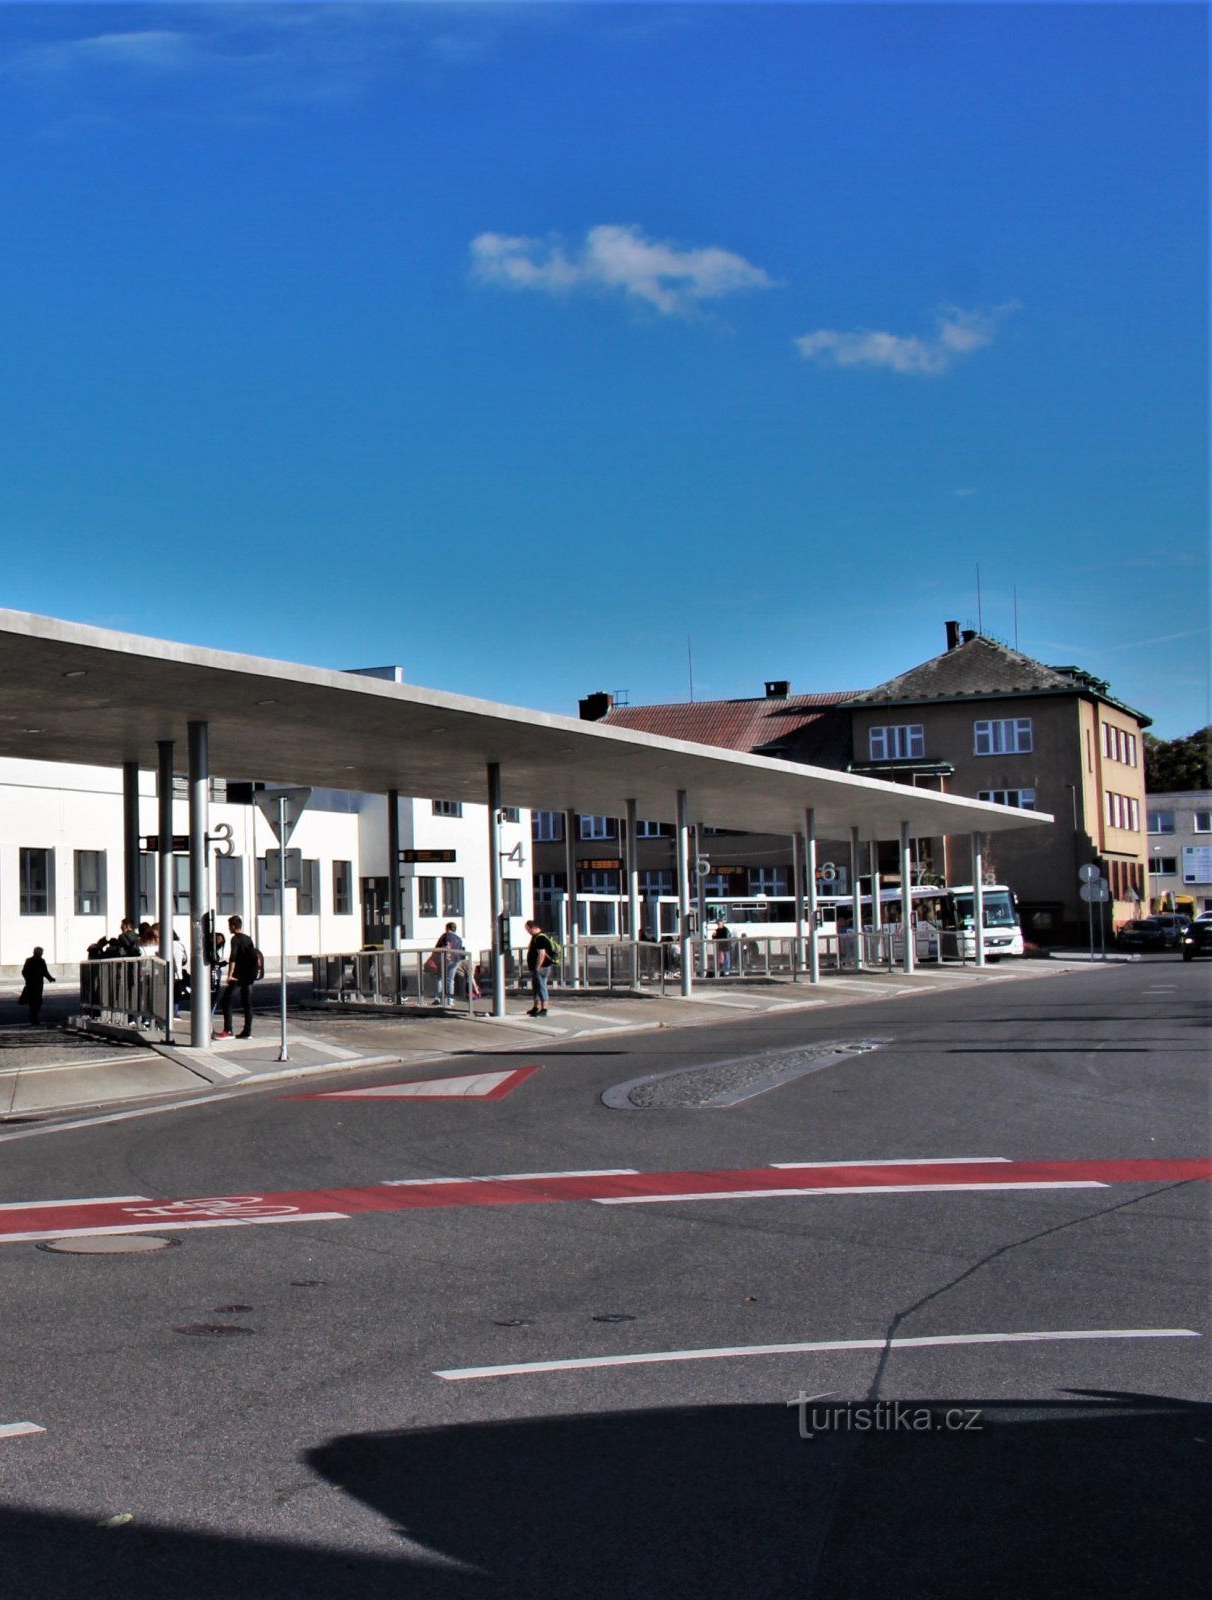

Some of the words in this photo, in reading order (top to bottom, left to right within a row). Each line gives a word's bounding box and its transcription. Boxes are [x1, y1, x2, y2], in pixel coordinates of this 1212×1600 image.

[214, 823, 236, 857] 3
[507, 841, 526, 868] 4
[696, 853, 711, 876] 5
[822, 861, 836, 881] 6
